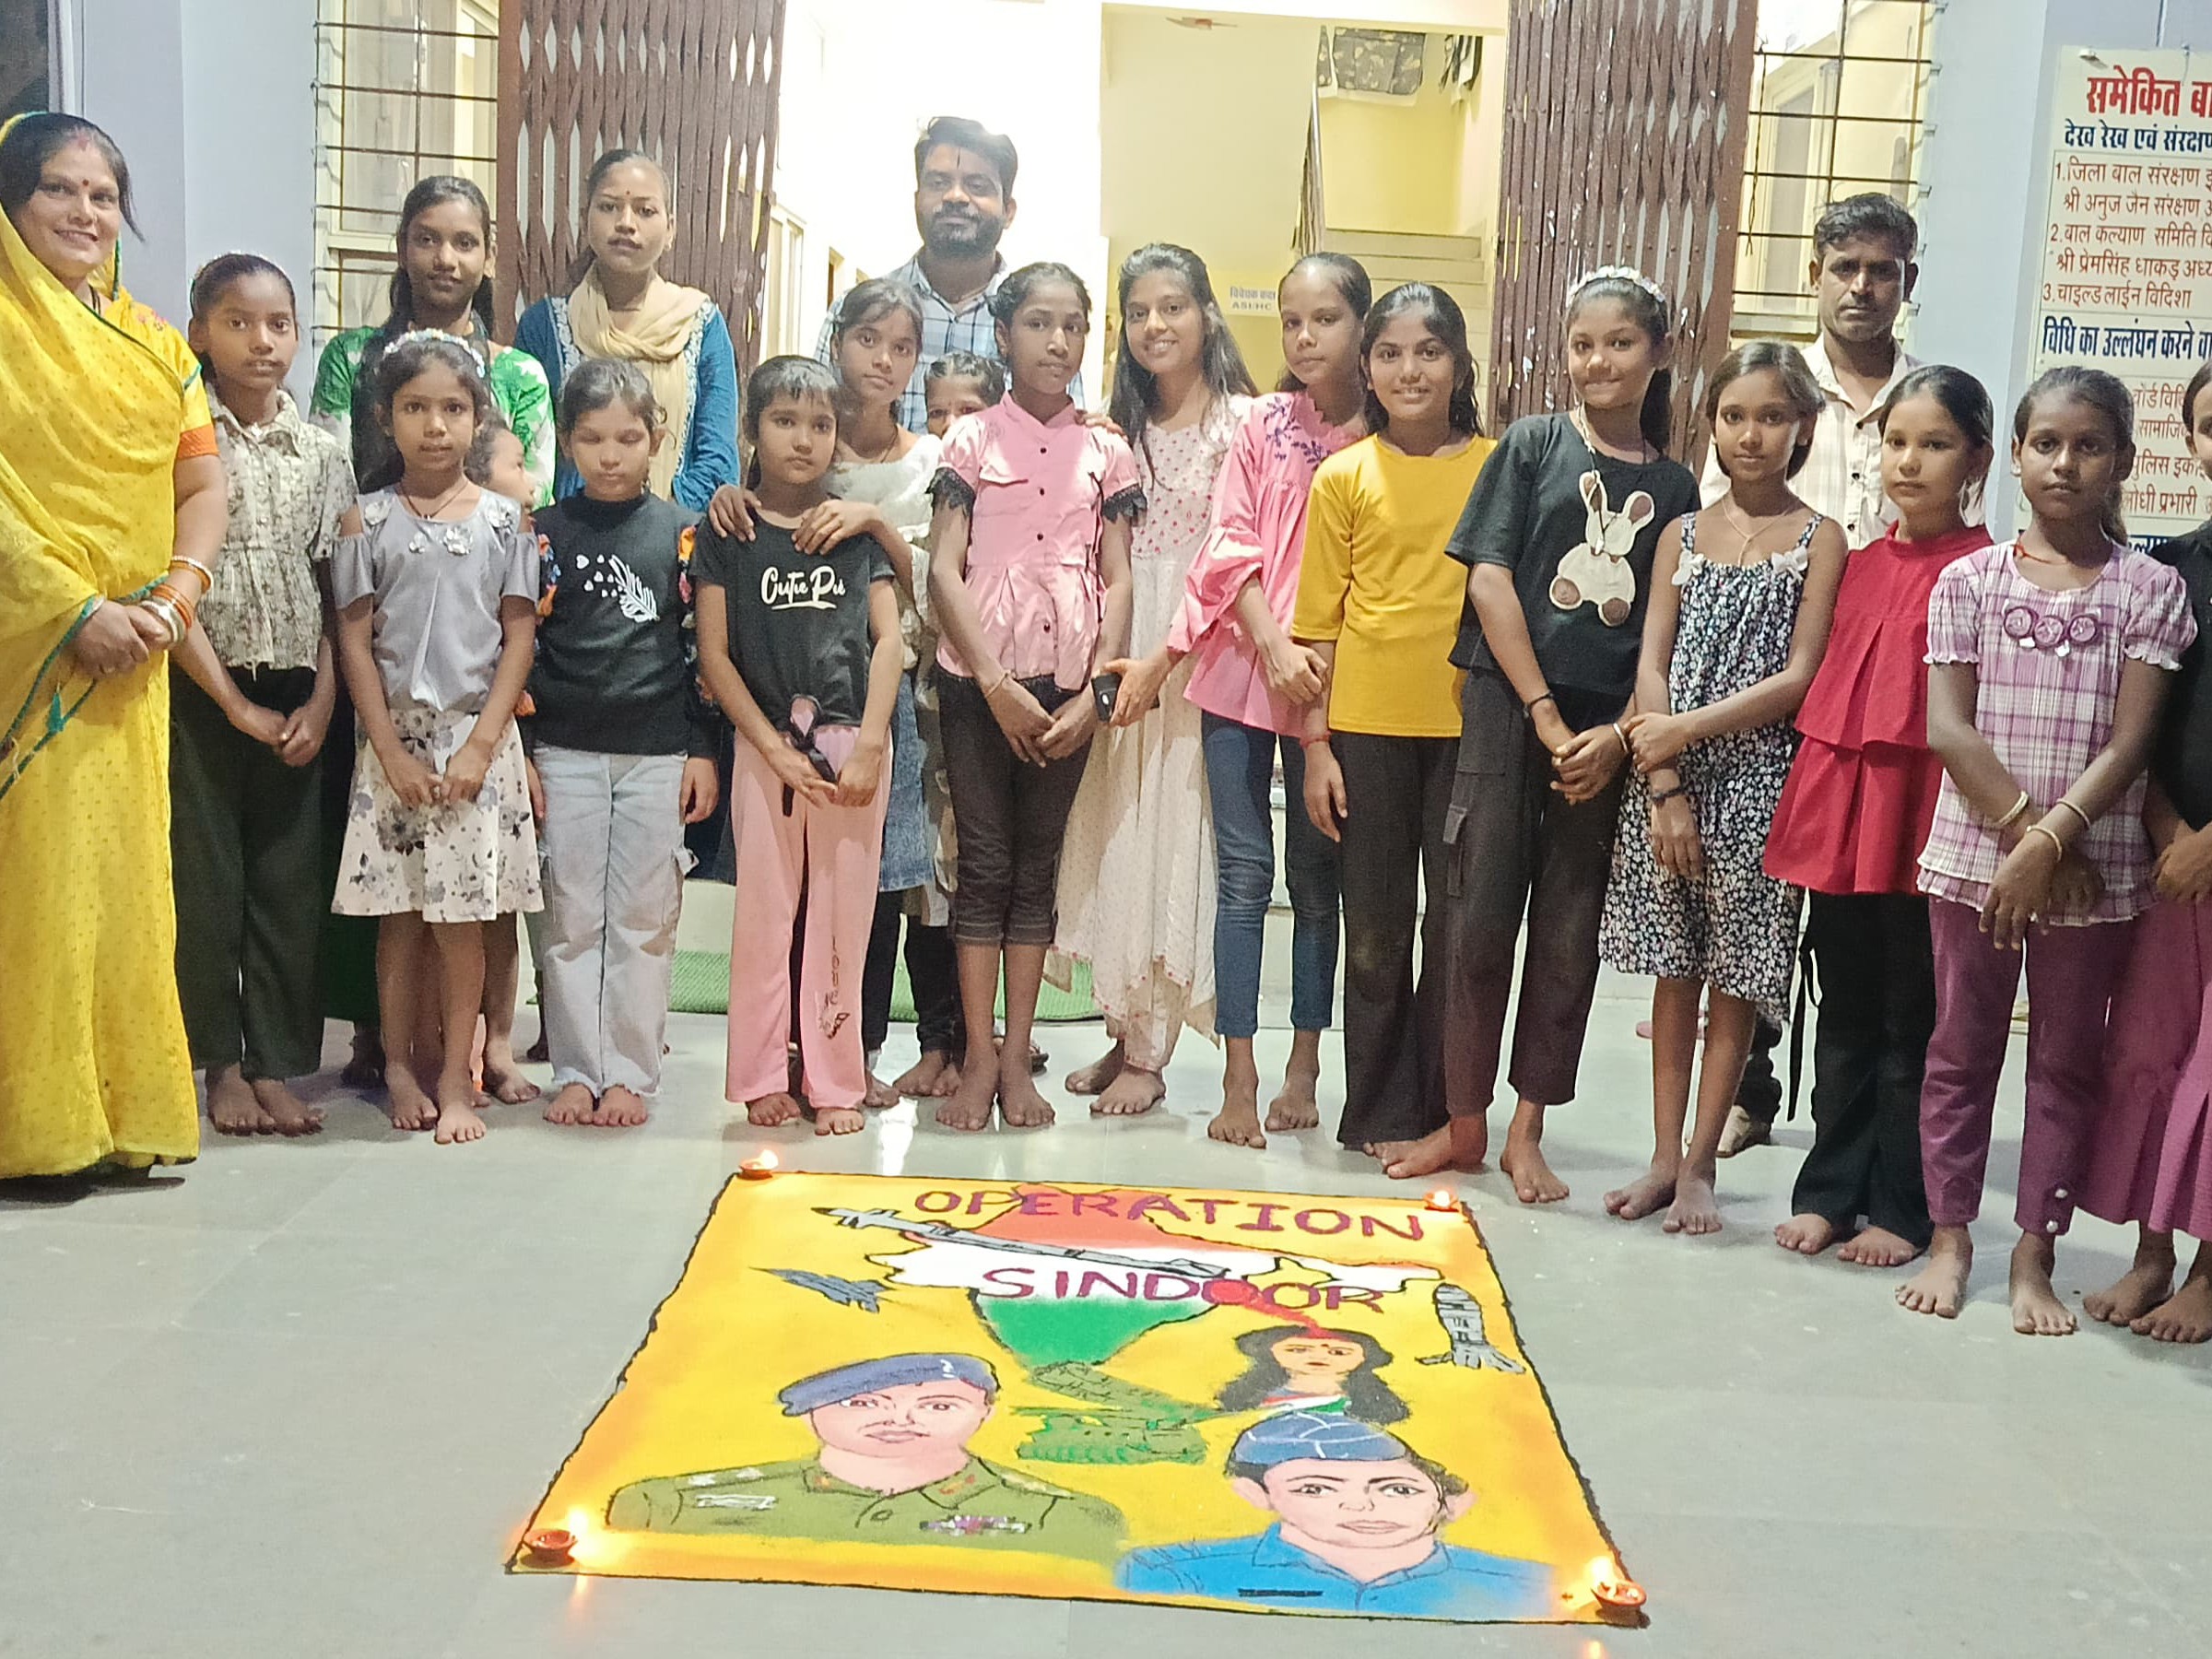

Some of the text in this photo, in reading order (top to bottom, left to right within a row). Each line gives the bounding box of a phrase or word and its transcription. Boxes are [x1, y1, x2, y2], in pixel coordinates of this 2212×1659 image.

[2087, 65, 2181, 116] समेकित
[2065, 118, 2096, 147] देख
[2099, 119, 2129, 147] रेख
[2134, 124, 2159, 150] एवं
[2147, 161, 2201, 187] संरक्षण
[2064, 186, 2081, 213] श्री
[2085, 194, 2123, 221] अनुज
[2125, 188, 2150, 215] जैन
[2154, 194, 2201, 218] संरक्षण
[2095, 224, 2147, 246] कल्याण
[2154, 220, 2197, 248] समिति
[2056, 247, 2076, 274] श्री
[2079, 248, 2131, 277] प्रेमसिंह
[2136, 256, 2181, 281] धाकड़
[2103, 280, 2142, 311] लाईन
[2145, 280, 2192, 310] विदिशा
[2041, 315, 2077, 355] विधि
[2078, 325, 2100, 357] का
[2160, 320, 2195, 360] करने
[2159, 485, 2198, 515] प्रभारी
[913, 1189, 1426, 1242] OPERATION
[981, 1266, 1385, 1314] SINDOOR
